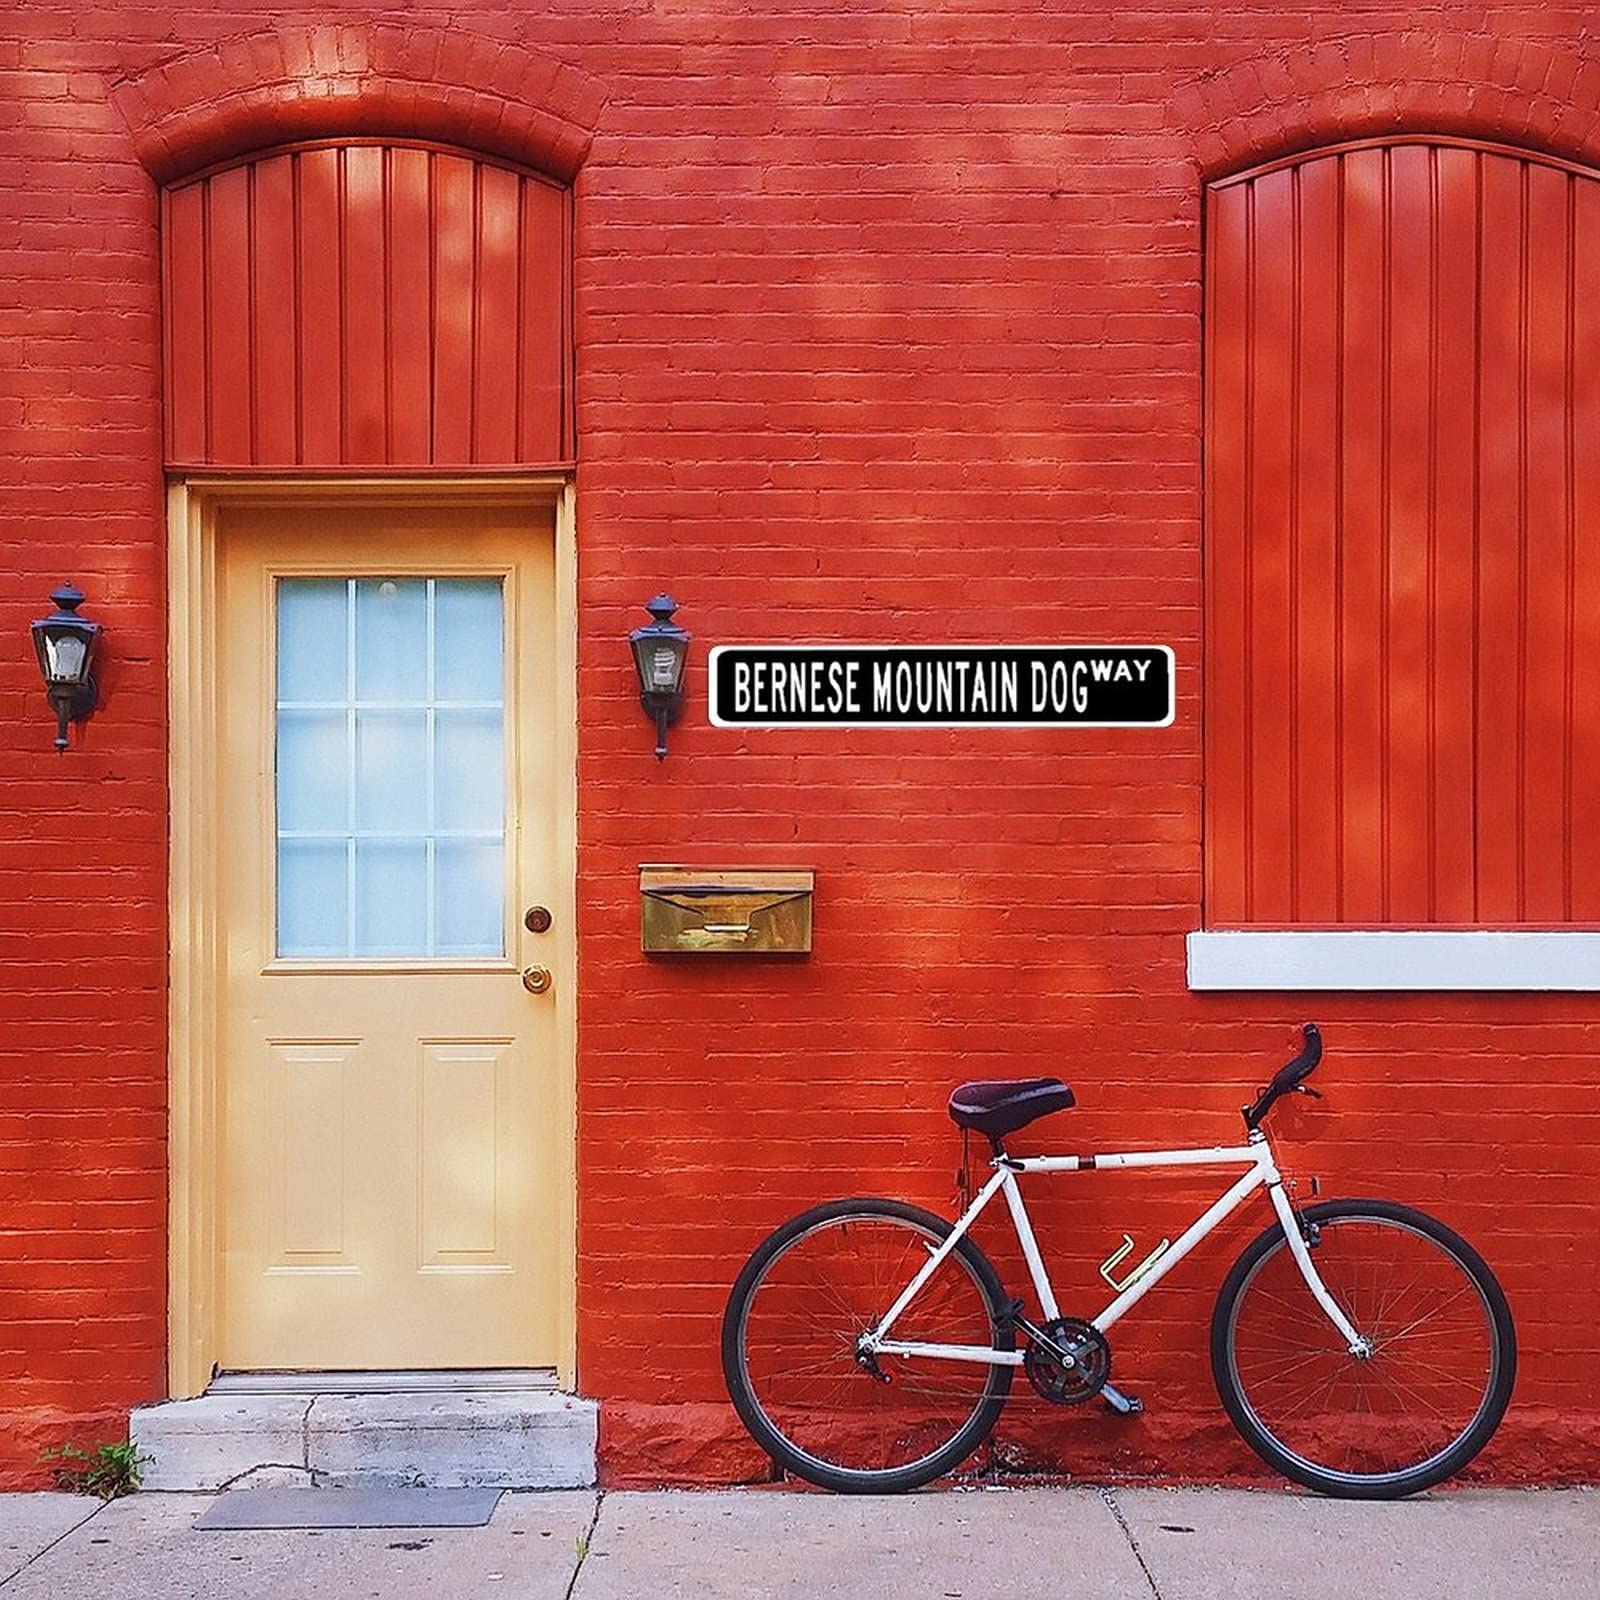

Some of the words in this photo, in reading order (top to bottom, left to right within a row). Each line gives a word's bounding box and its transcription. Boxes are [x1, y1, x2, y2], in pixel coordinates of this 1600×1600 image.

[734, 662, 861, 713] BERNESE
[873, 661, 1018, 713] MOUNTAIN
[1031, 661, 1088, 713] DOG
[1090, 659, 1152, 682] WAY
